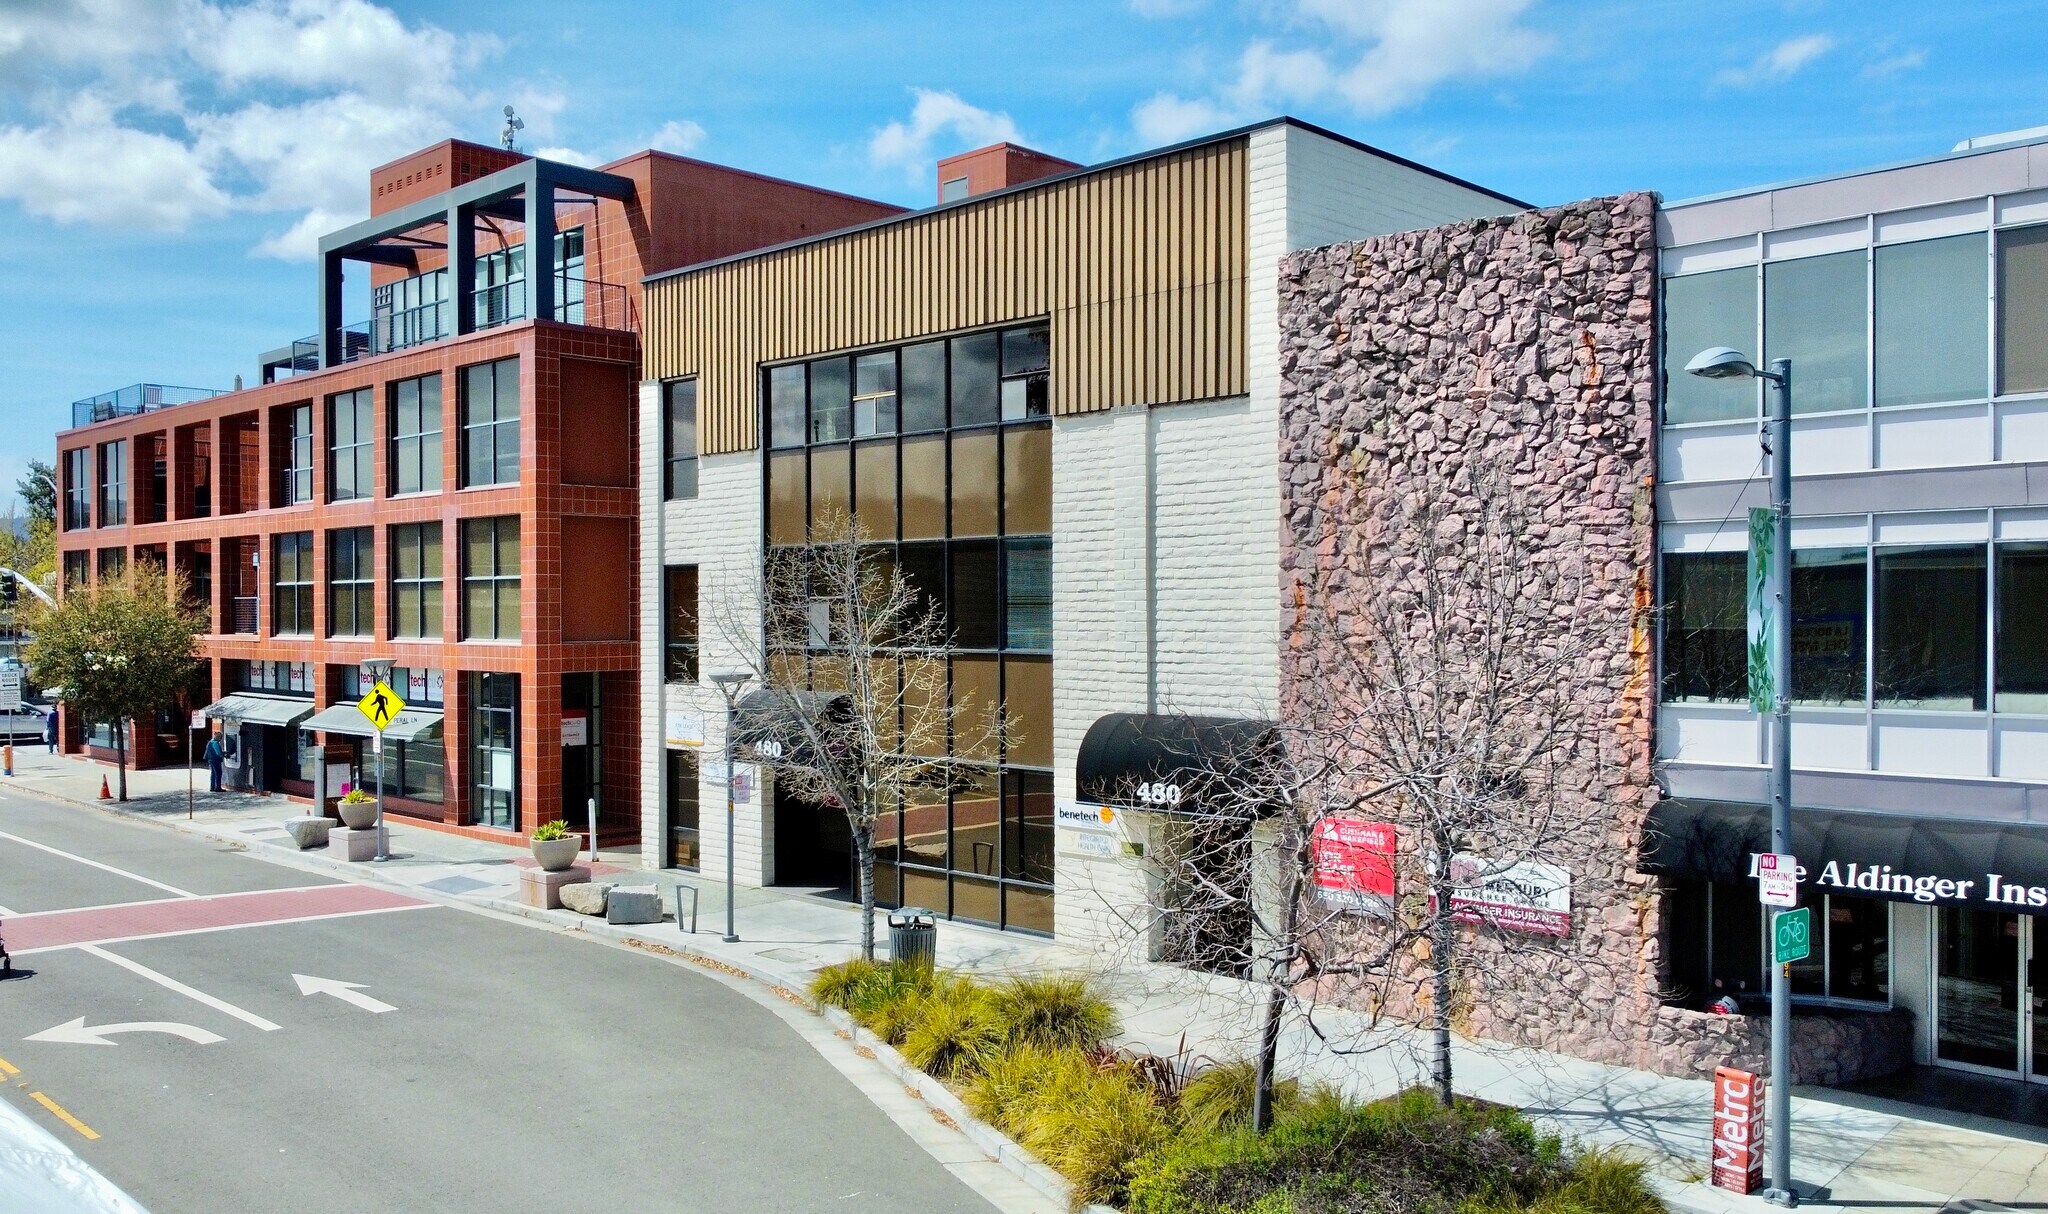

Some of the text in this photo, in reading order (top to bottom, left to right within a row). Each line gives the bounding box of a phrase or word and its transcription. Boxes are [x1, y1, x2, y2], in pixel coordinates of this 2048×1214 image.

[410, 674, 425, 687] tech
[754, 740, 782, 758] 480
[1136, 782, 1181, 805] 480
[1059, 807, 1098, 823] benetech
[1340, 834, 1385, 846] WAKEFIELD
[1762, 856, 1775, 868] NO
[1763, 870, 1793, 882] PARKING
[1816, 860, 1974, 902] Aldinger
[1504, 908, 1563, 925] INSURANCE
[1777, 948, 1790, 961] BIKE
[1714, 1079, 1749, 1173] Metro
[1748, 1077, 1765, 1172] Metro
